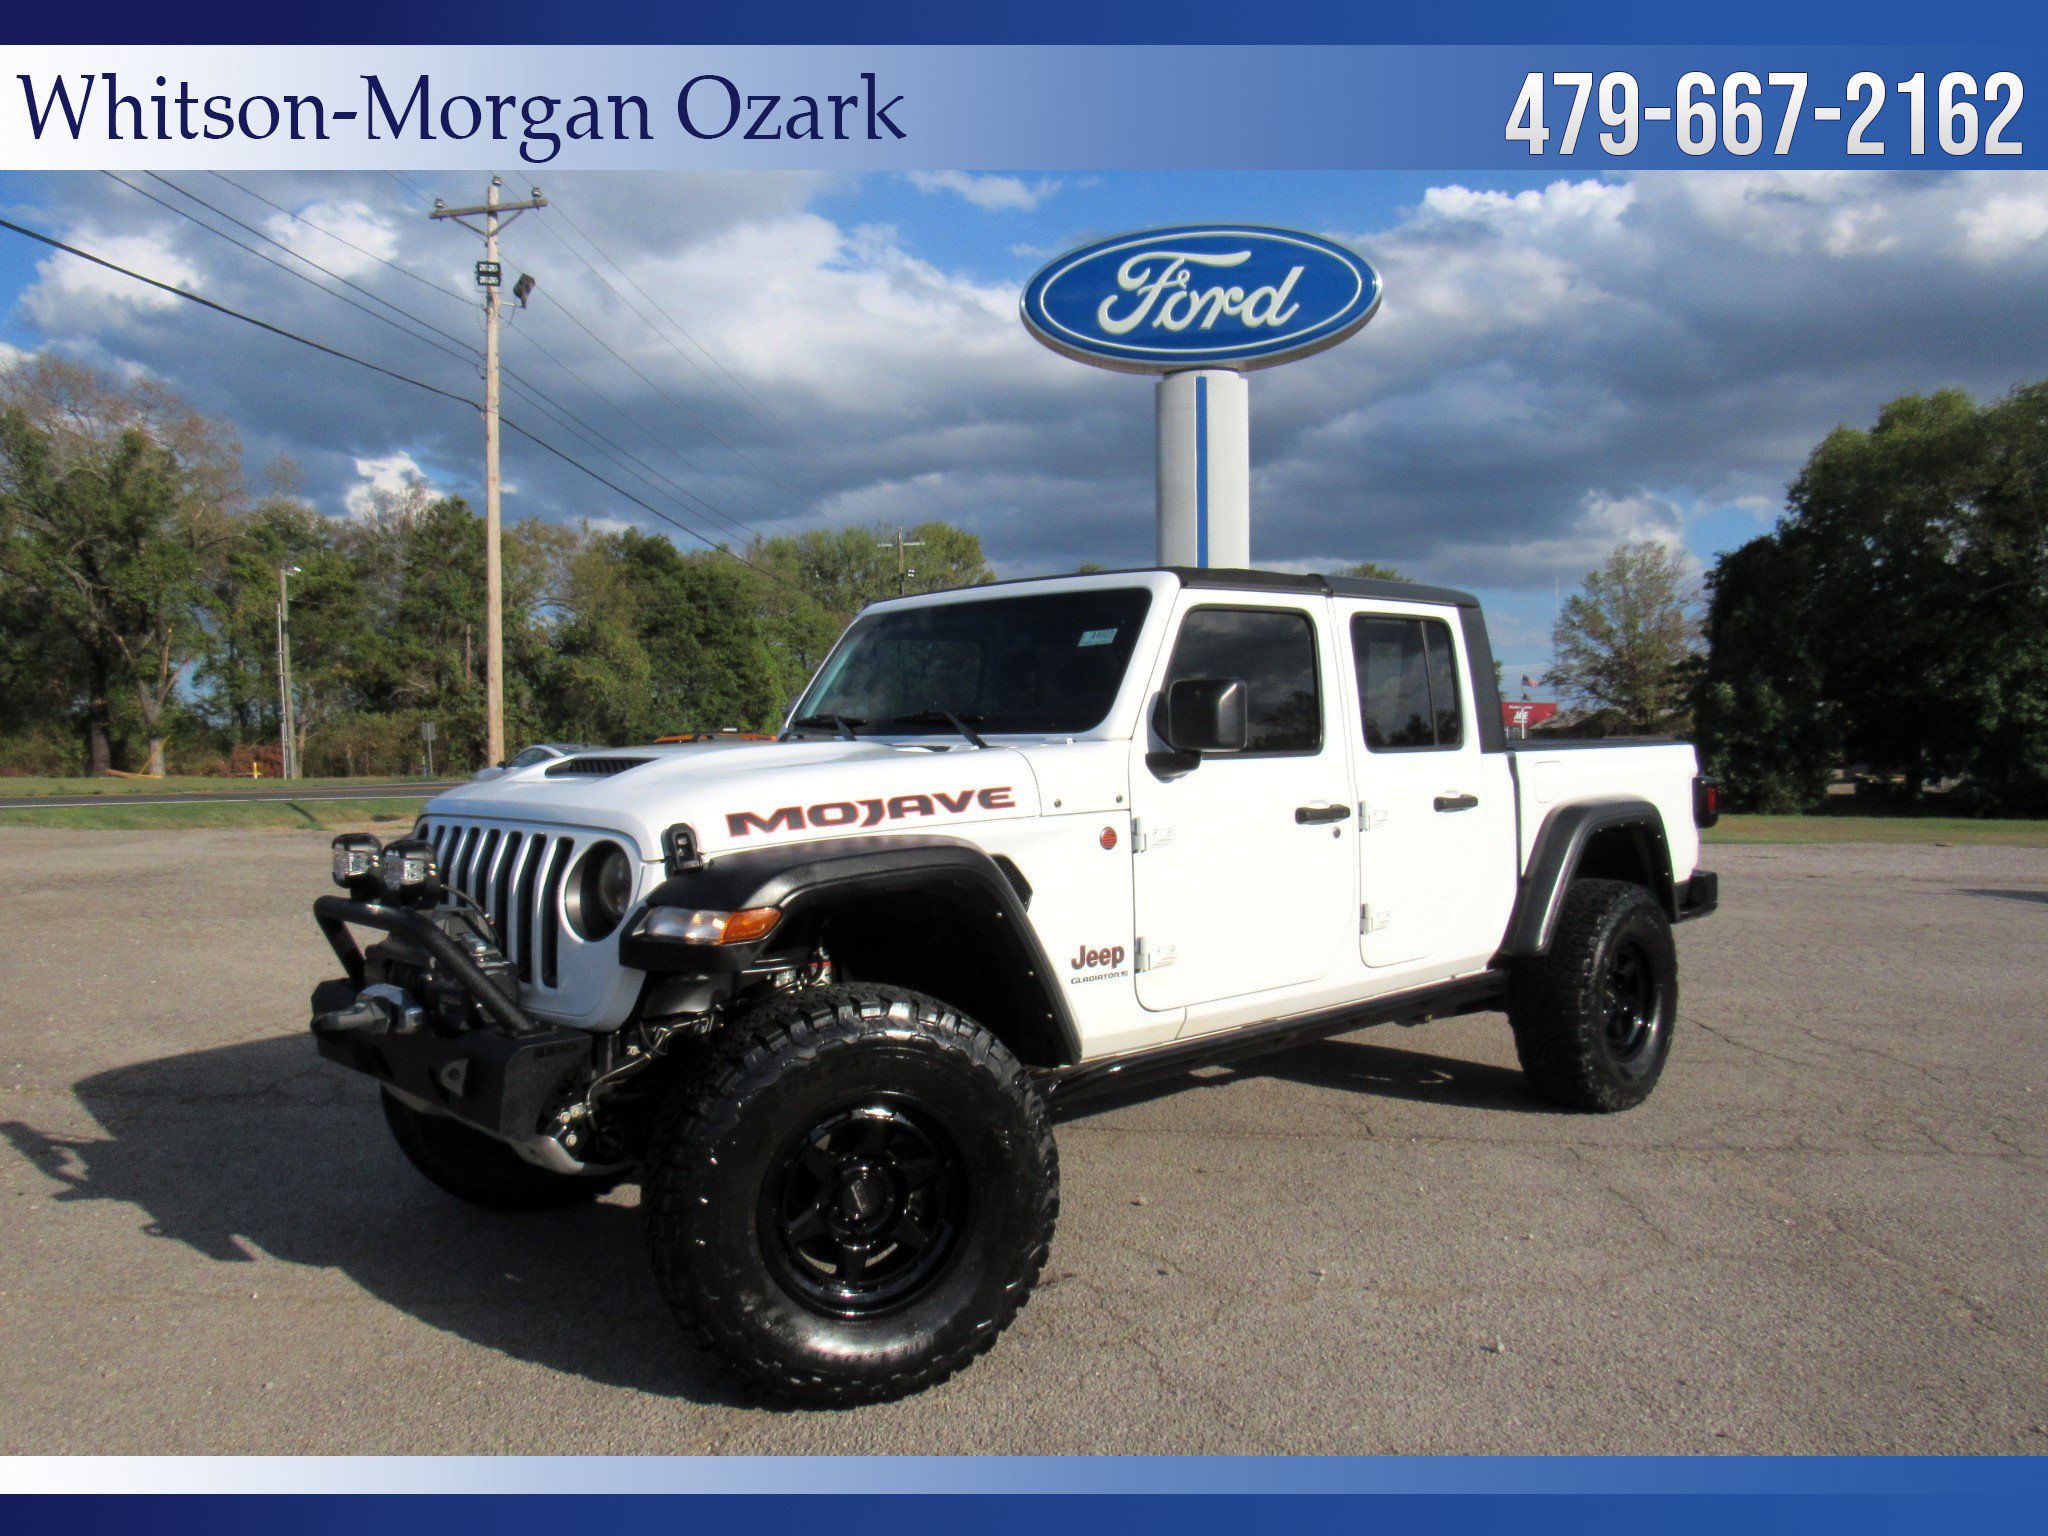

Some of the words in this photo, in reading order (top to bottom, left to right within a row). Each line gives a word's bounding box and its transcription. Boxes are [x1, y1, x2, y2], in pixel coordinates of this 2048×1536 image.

[1099, 250, 1304, 334] Ford
[725, 786, 1016, 837] MOJAVE
[1070, 944, 1125, 970] Jeep
[1070, 971, 1120, 985] GLADIATOR
